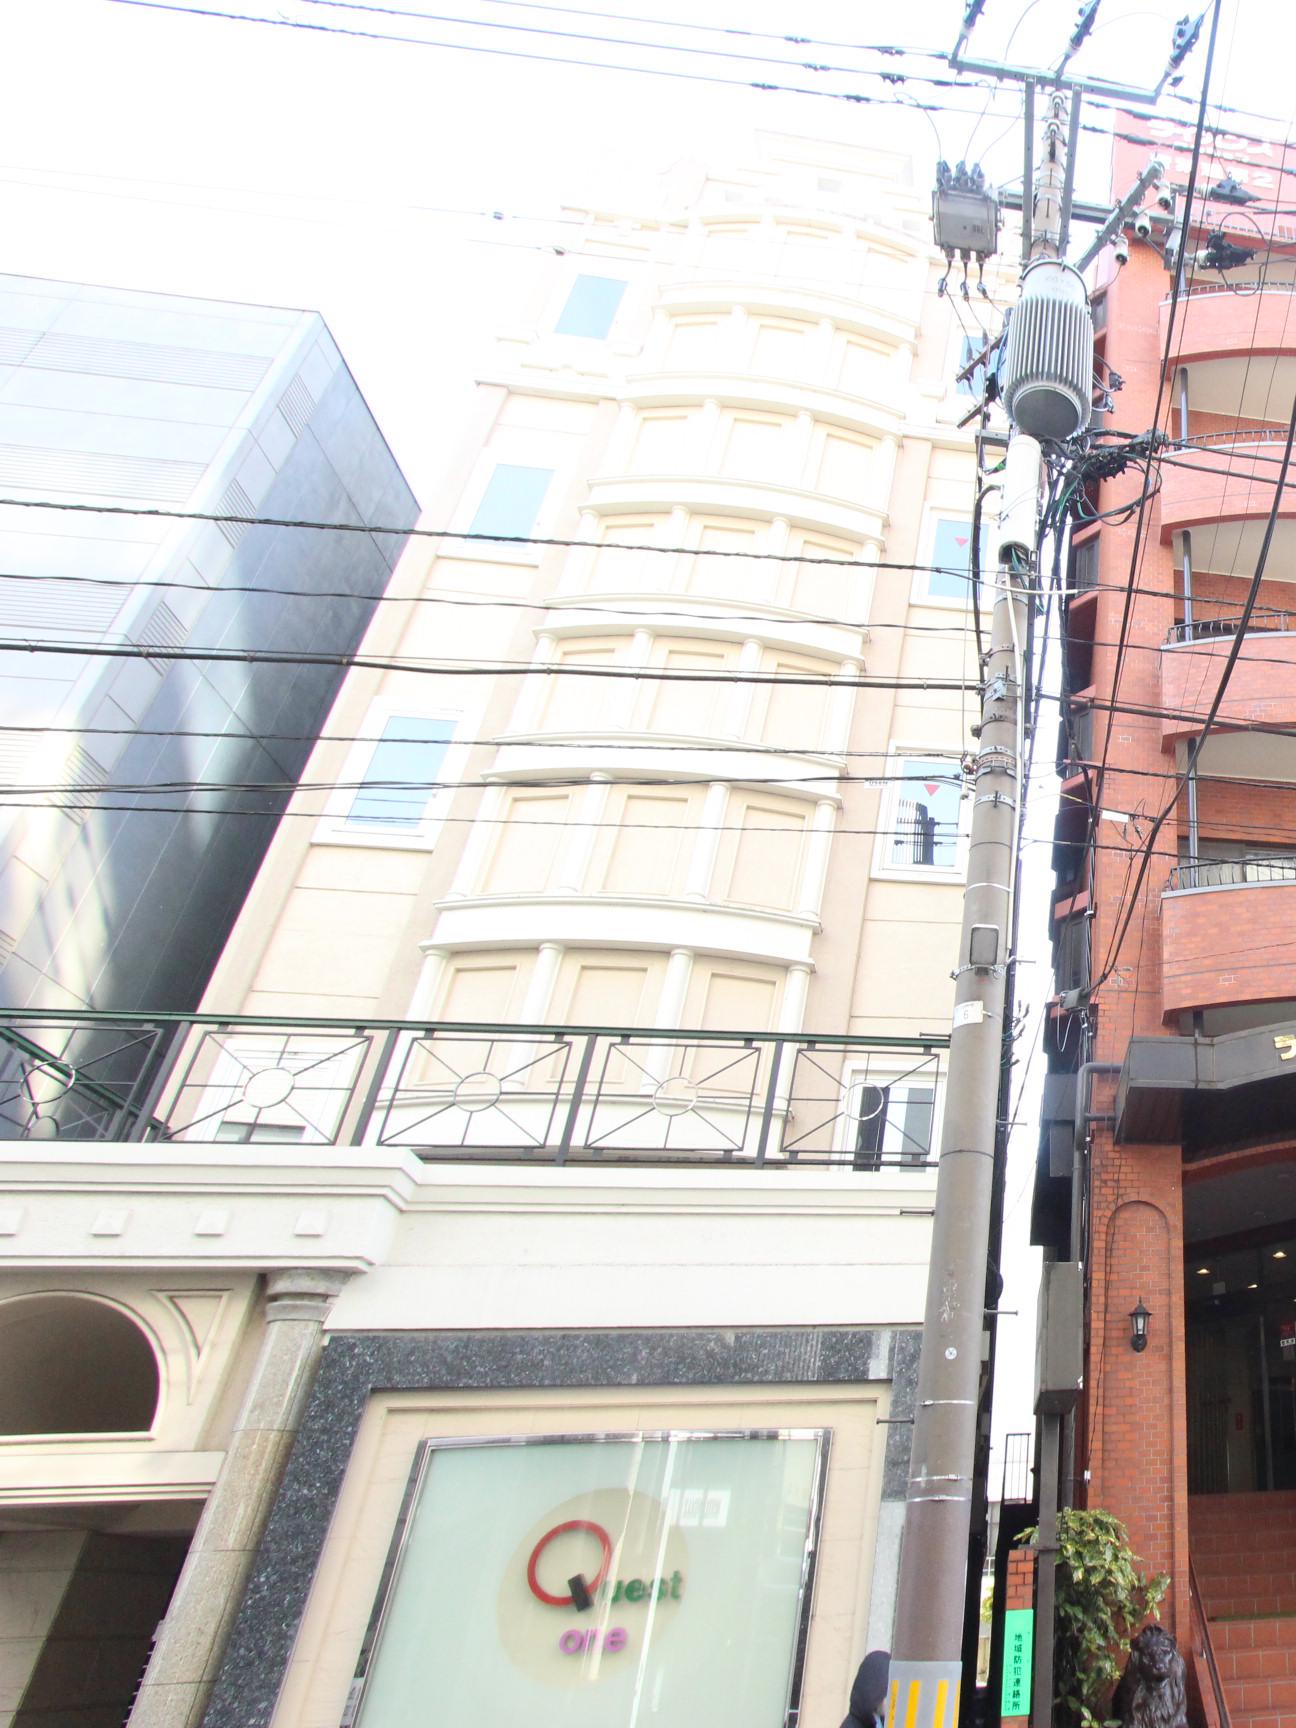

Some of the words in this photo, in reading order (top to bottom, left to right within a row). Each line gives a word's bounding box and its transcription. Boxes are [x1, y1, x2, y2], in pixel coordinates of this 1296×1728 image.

[527, 1519, 683, 1612] Quest
[559, 1626, 628, 1655] one
[1012, 1633, 1023, 1711] 地域防犯連絡所
